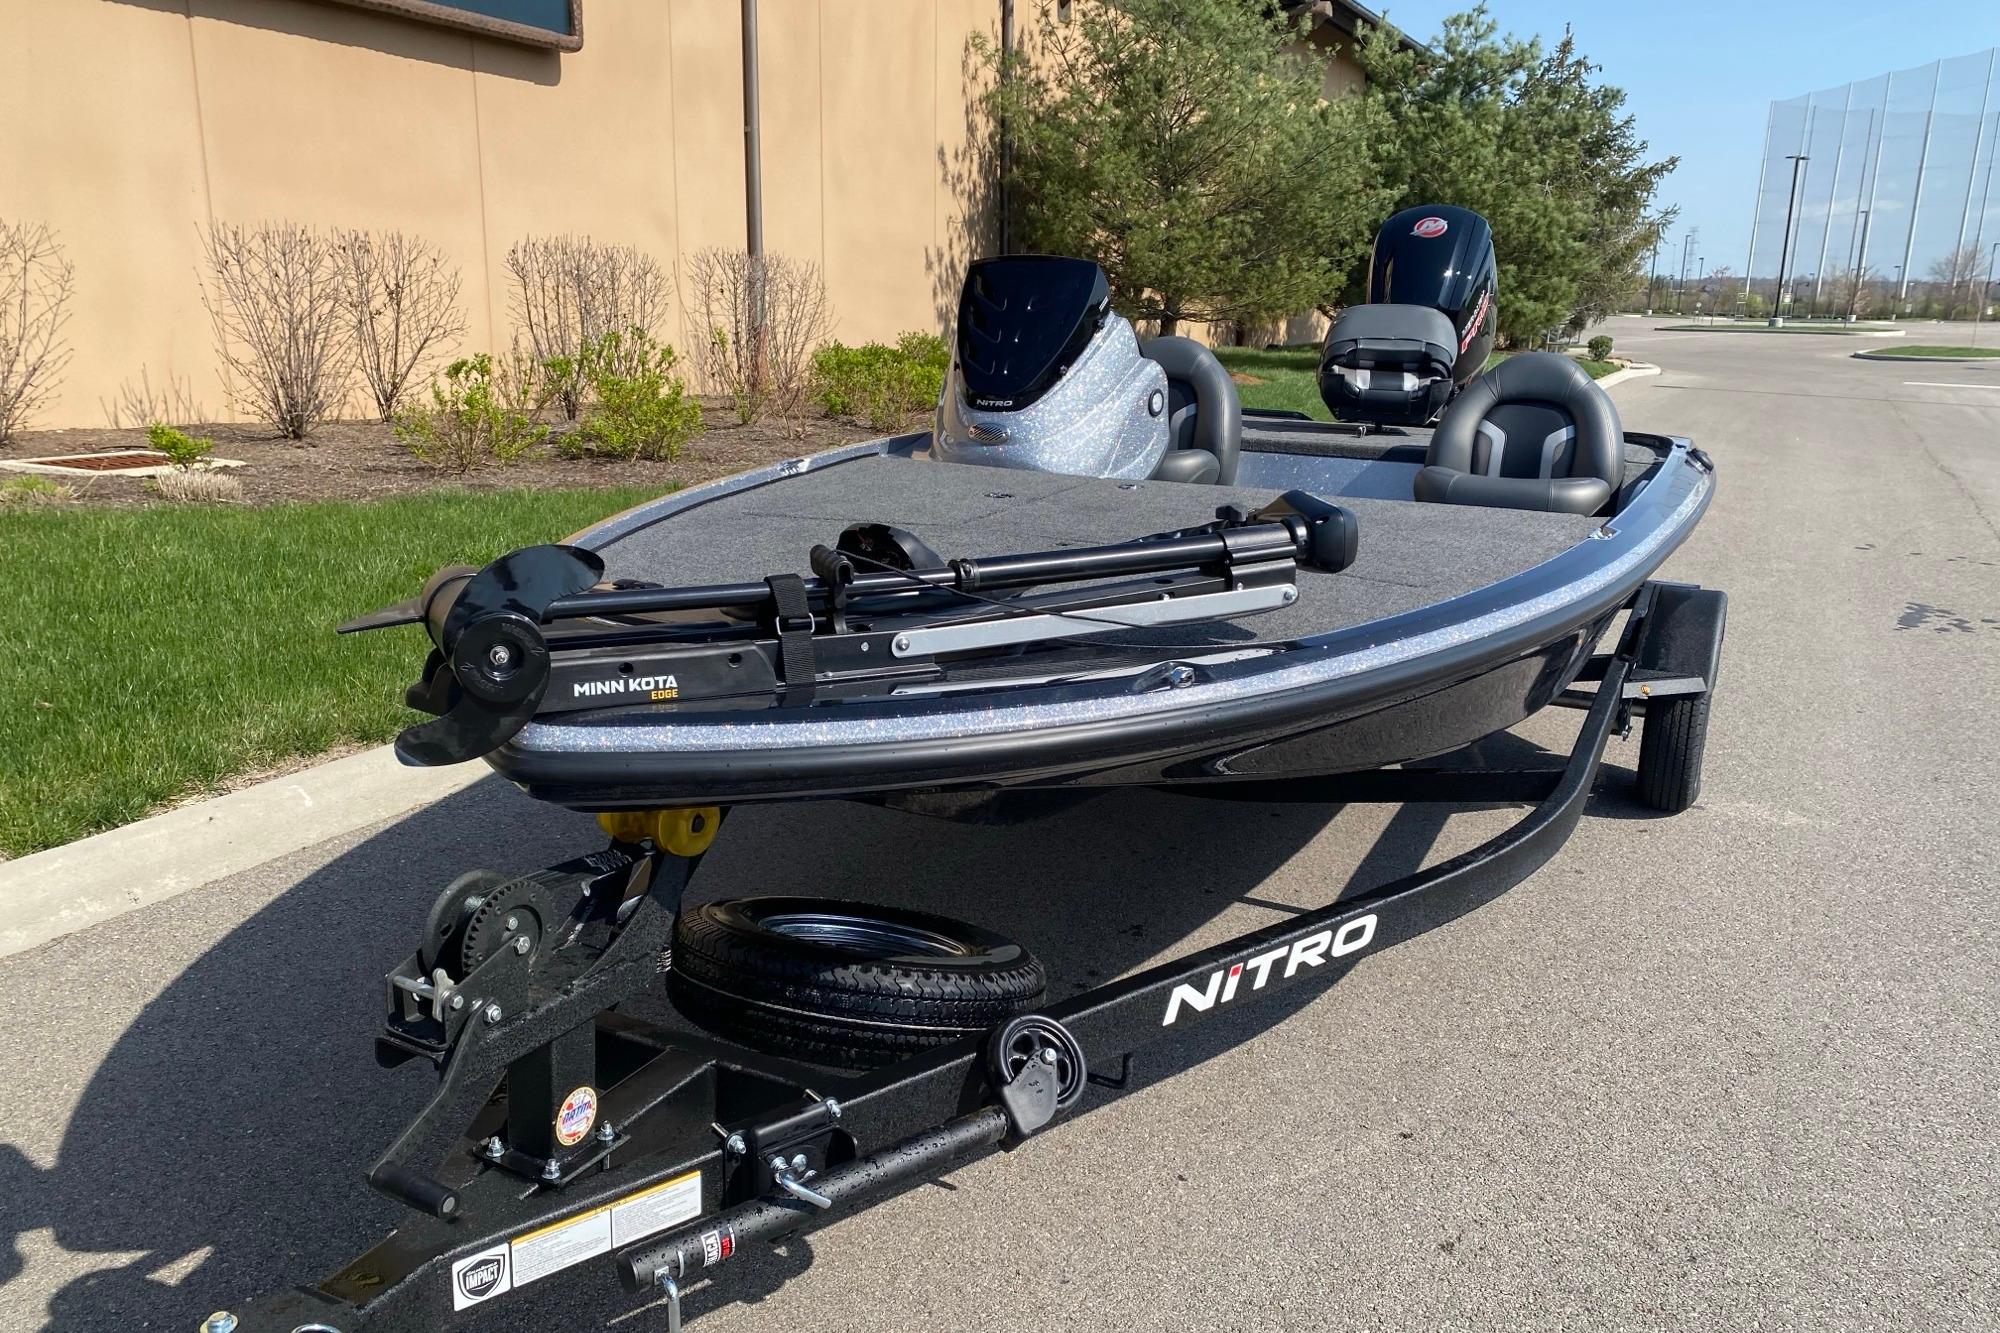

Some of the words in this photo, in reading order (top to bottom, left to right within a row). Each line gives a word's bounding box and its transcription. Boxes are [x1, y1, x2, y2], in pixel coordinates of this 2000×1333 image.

[976, 399, 1013, 407] NITRO
[573, 679, 625, 698] MINN
[628, 674, 679, 693] KOTA
[650, 688, 679, 700] EDGE
[1162, 913, 1378, 1027] NITRO
[465, 1264, 499, 1291] IMPACT
